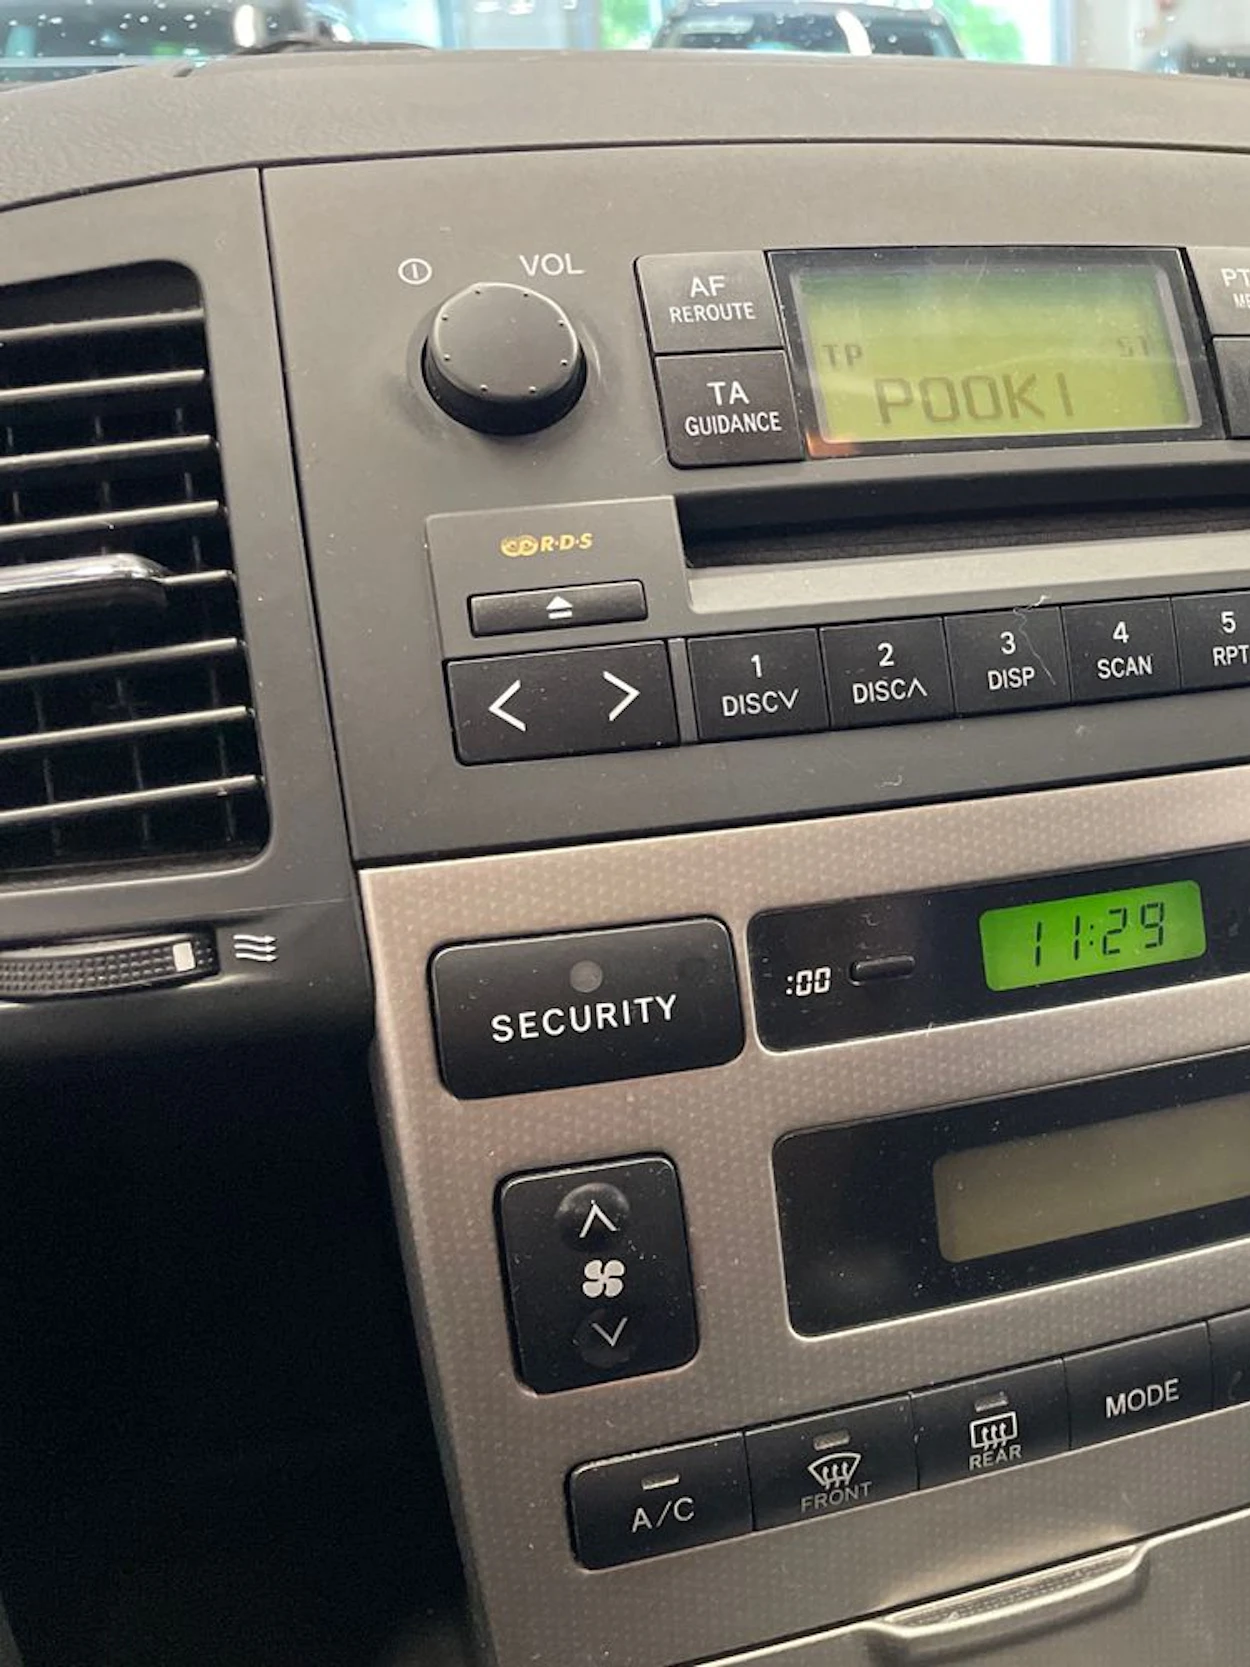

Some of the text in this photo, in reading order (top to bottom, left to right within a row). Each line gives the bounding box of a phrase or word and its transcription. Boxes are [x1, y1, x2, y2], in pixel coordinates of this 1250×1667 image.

[519, 253, 584, 277] VOL
[690, 276, 726, 298] AF
[669, 301, 756, 323] REROUTE
[822, 343, 863, 369] TP
[707, 379, 750, 406] TA
[684, 410, 782, 437] GUIDANCE
[1112, 620, 1130, 644] 4
[1220, 611, 1236, 634] 5
[877, 642, 895, 667] 2
[1000, 631, 1016, 655] 3
[1212, 644, 1250, 667] RPT
[750, 654, 764, 678] 1
[1097, 655, 1153, 680] SCAN
[987, 667, 1035, 691] DISP
[1034, 902, 1165, 967] 11:29
[490, 994, 678, 1043] SECURITY
[1105, 1378, 1180, 1418] MODE
[968, 1443, 1022, 1471] REAR
[800, 1480, 873, 1513] FRONT
[631, 1497, 695, 1534] A/C
